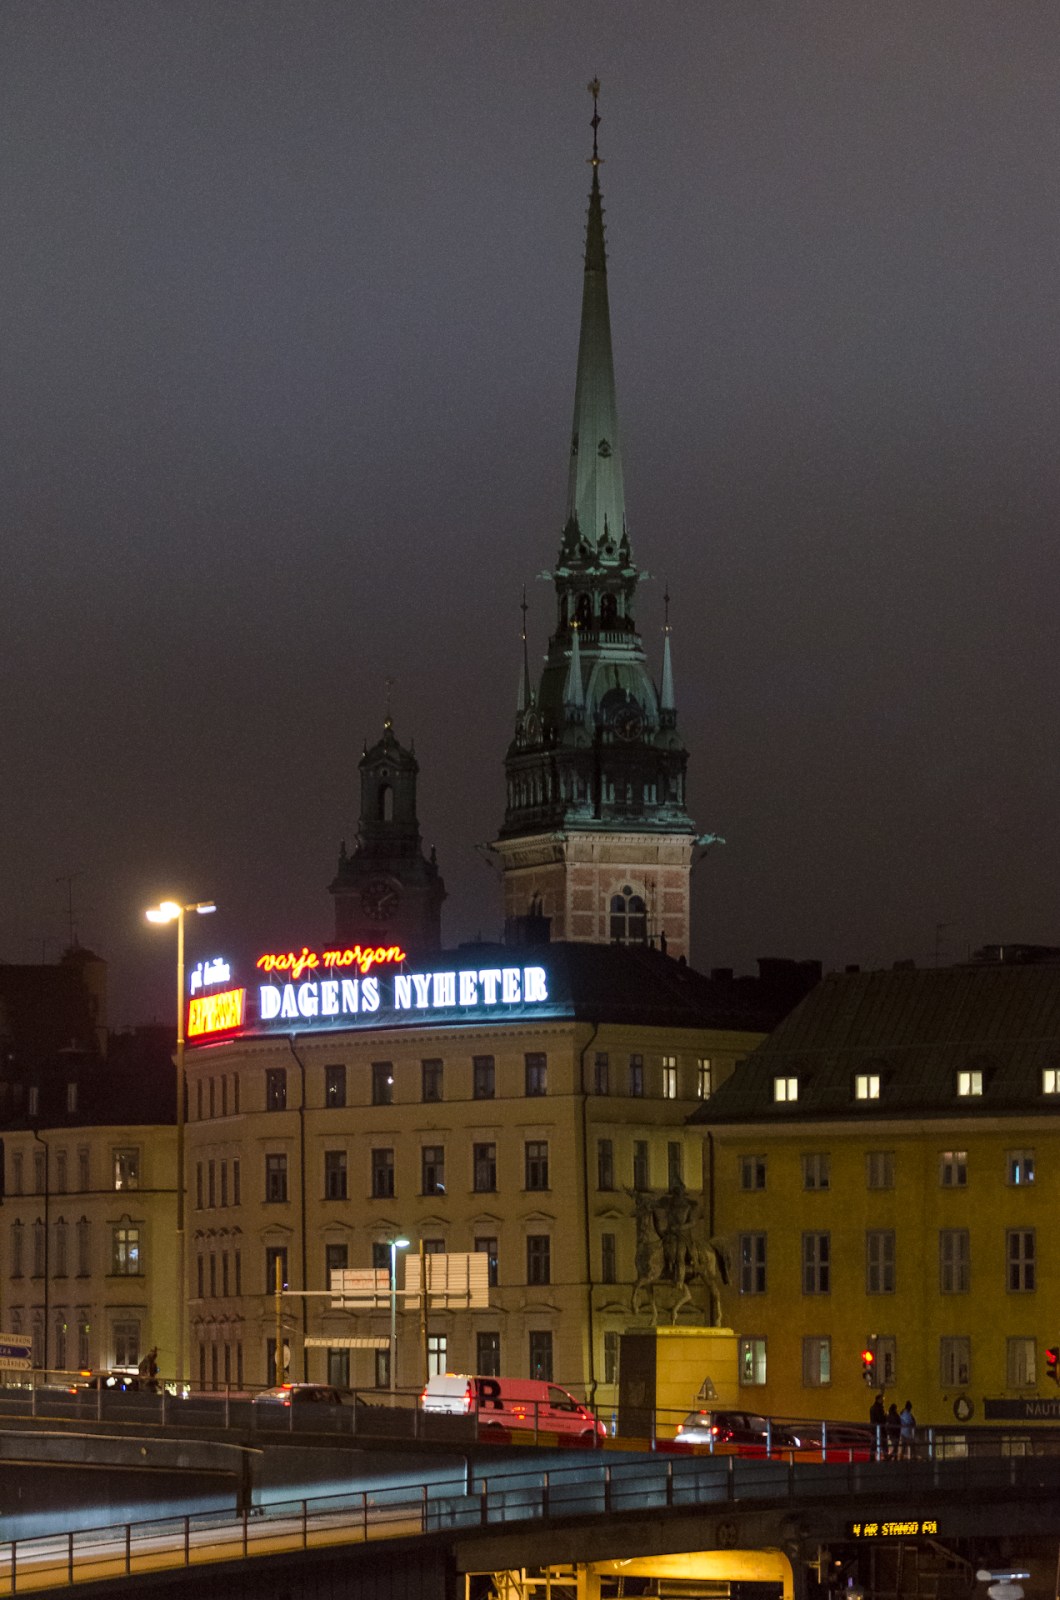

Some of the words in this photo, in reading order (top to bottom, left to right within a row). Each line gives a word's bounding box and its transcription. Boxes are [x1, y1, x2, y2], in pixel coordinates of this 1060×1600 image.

[257, 948, 319, 979] varje
[323, 945, 406, 973] morgon
[260, 977, 380, 1020] DAGENS
[394, 966, 548, 1010] NYHETER
